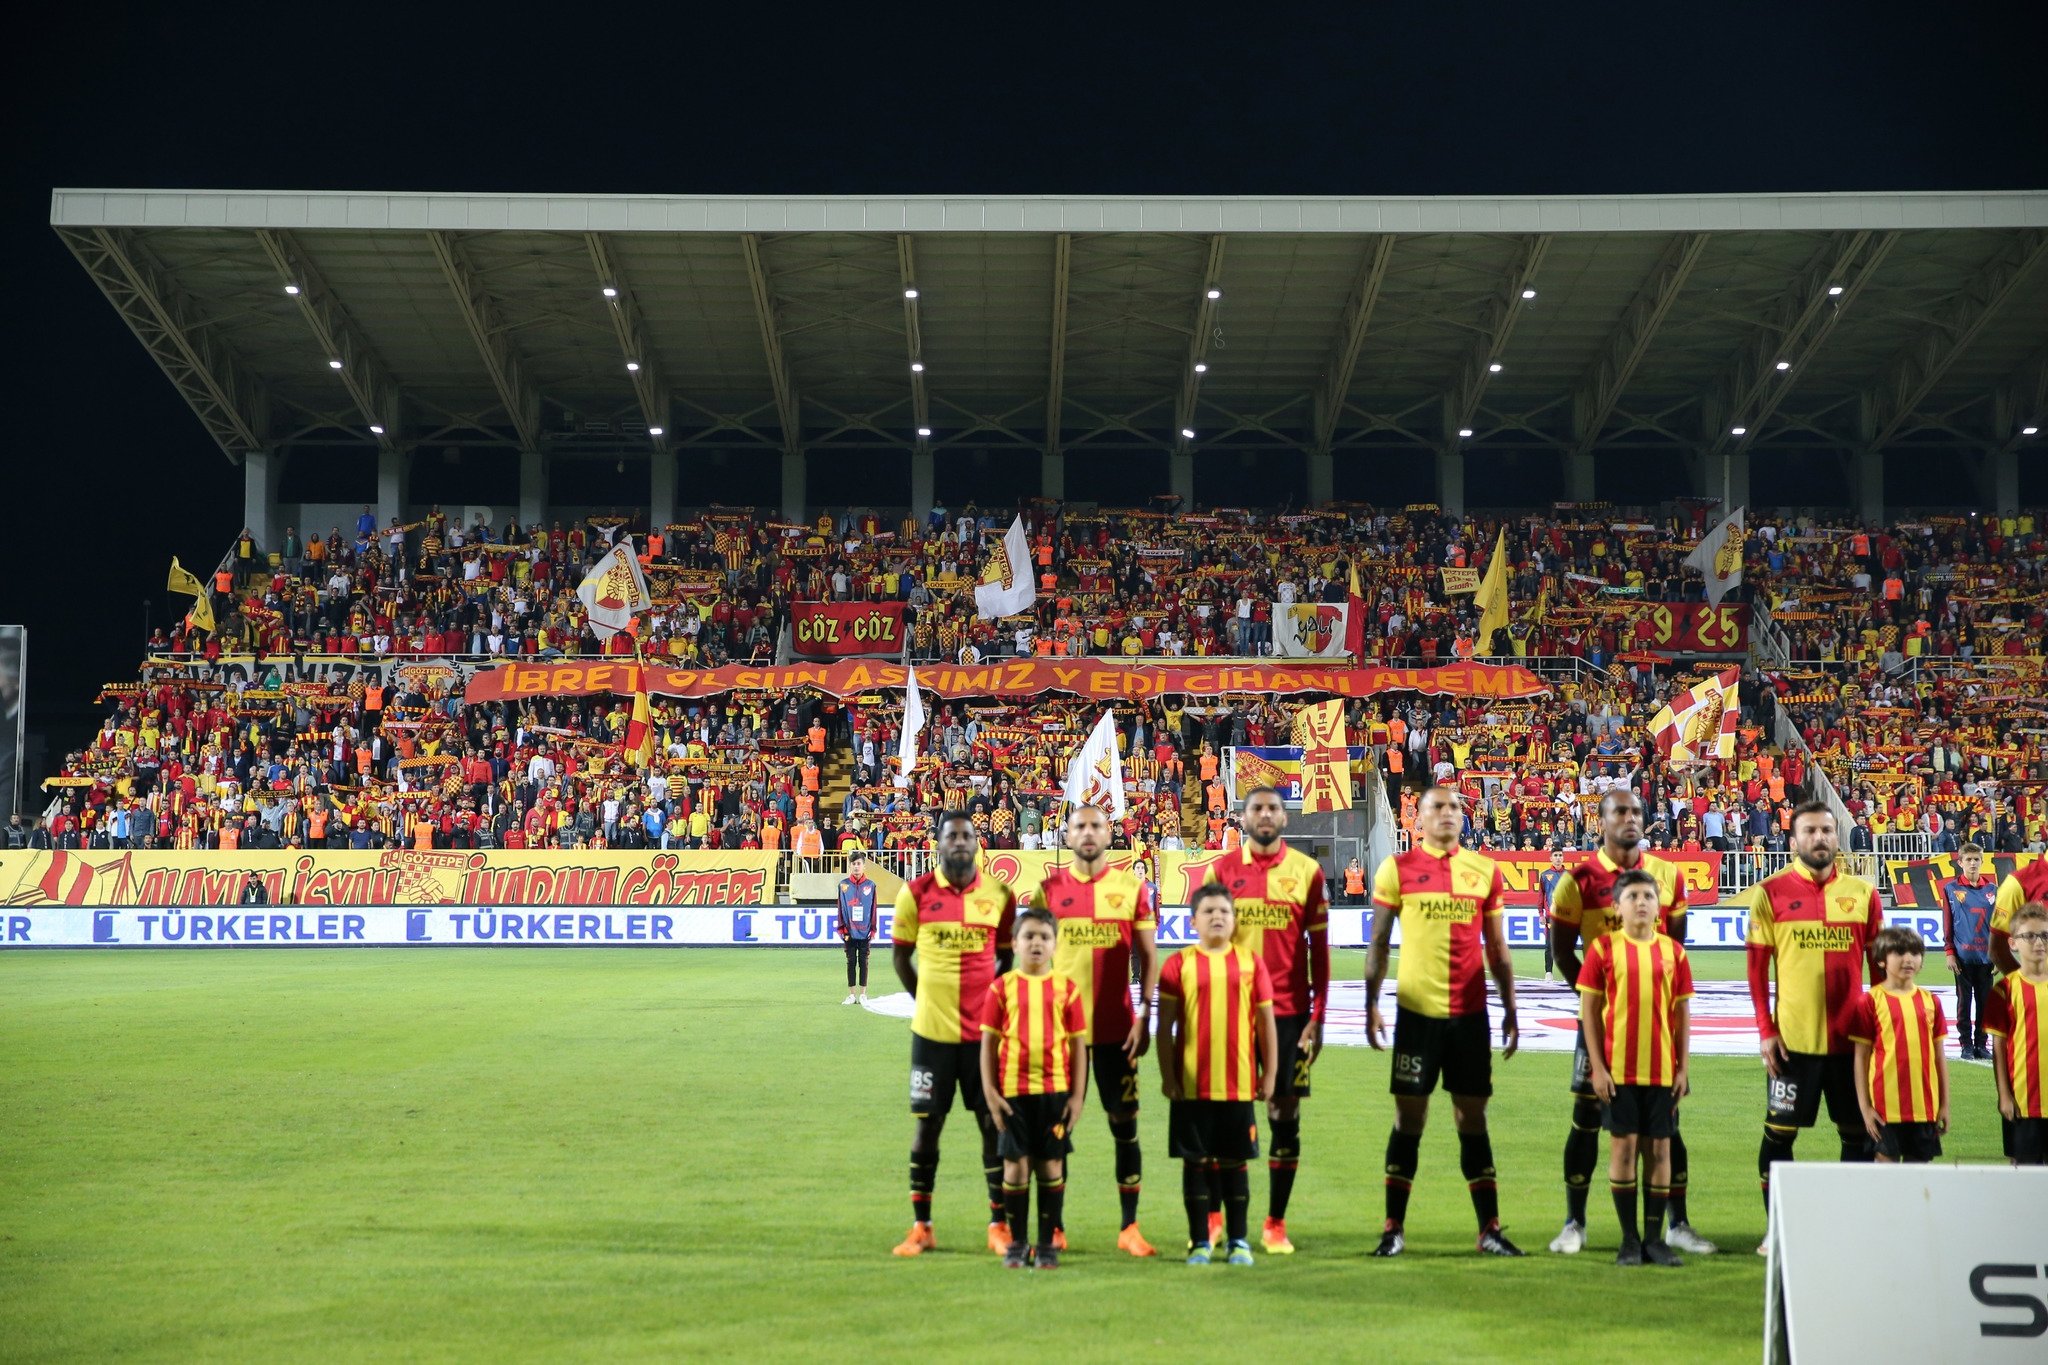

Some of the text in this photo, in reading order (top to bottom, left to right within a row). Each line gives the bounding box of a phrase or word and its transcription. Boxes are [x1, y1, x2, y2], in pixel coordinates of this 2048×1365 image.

[799, 610, 896, 644] GÖZ GÖZ
[1697, 605, 1740, 648] 25
[502, 663, 645, 692] İBRET
[666, 669, 828, 689] OLSUN
[1052, 666, 1166, 693] YEDİ
[403, 851, 464, 867] GÖZTEPE
[1420, 900, 1477, 914] MAHALL
[1969, 907, 1987, 933] 7
[137, 909, 366, 941] TÜRKERLER
[449, 907, 675, 940] TÜRKERLER
[1793, 928, 1853, 942] MAHALL
[1771, 1079, 1798, 1102] IBS
[1969, 1262, 2048, 1338] S
